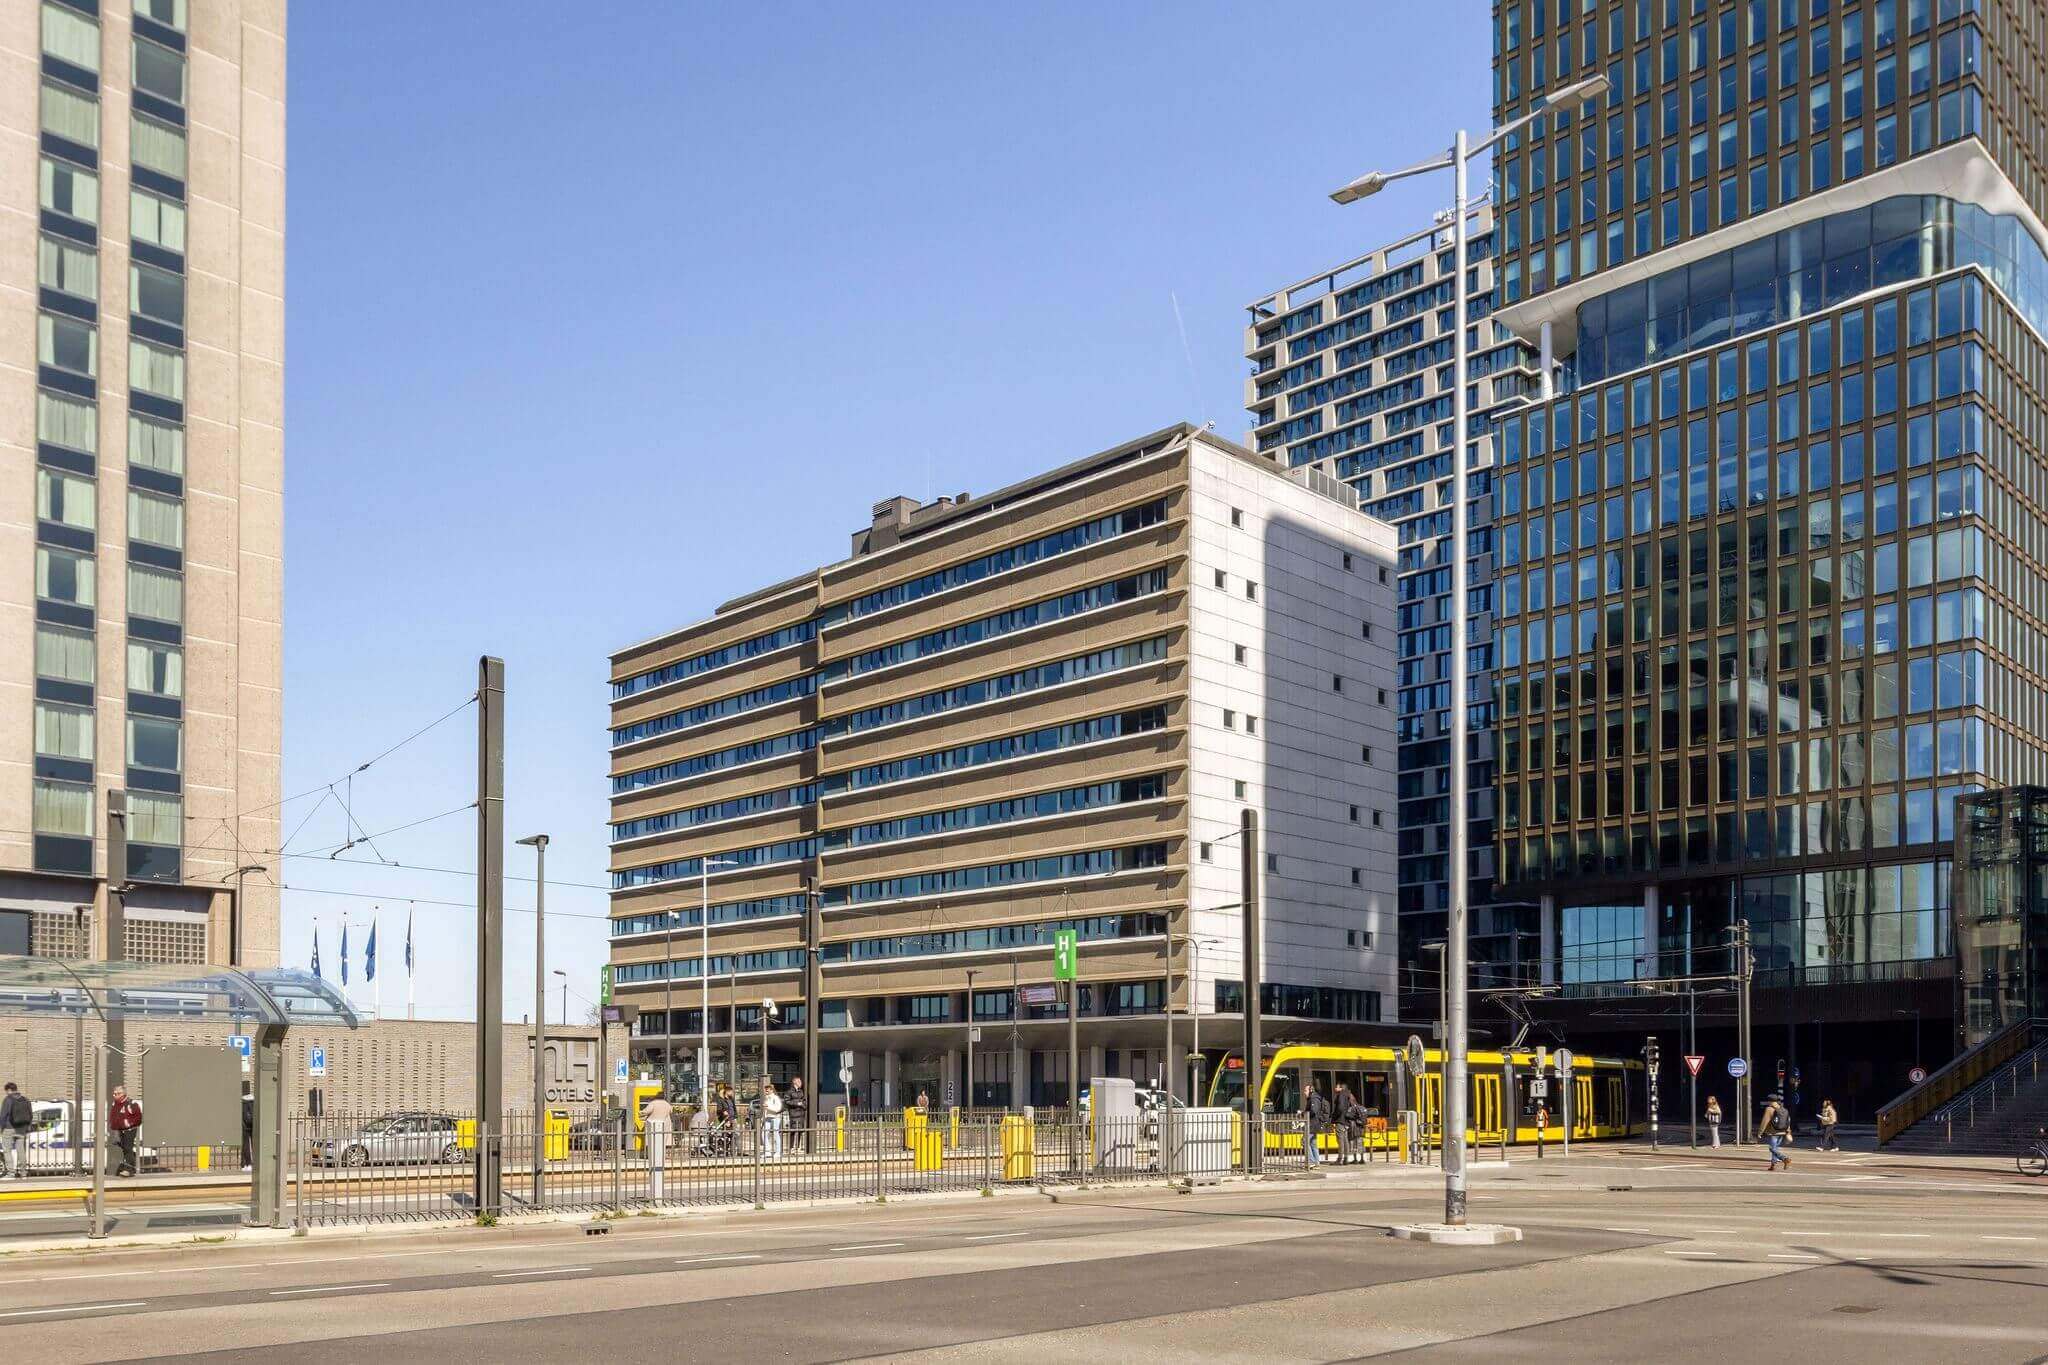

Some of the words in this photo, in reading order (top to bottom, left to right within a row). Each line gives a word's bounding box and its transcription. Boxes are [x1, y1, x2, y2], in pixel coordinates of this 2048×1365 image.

[1058, 935, 1069, 952] H
[1058, 951, 1068, 970] 1
[602, 970, 609, 983] H
[602, 983, 609, 997] 2
[536, 1087, 595, 1103] OTELS
